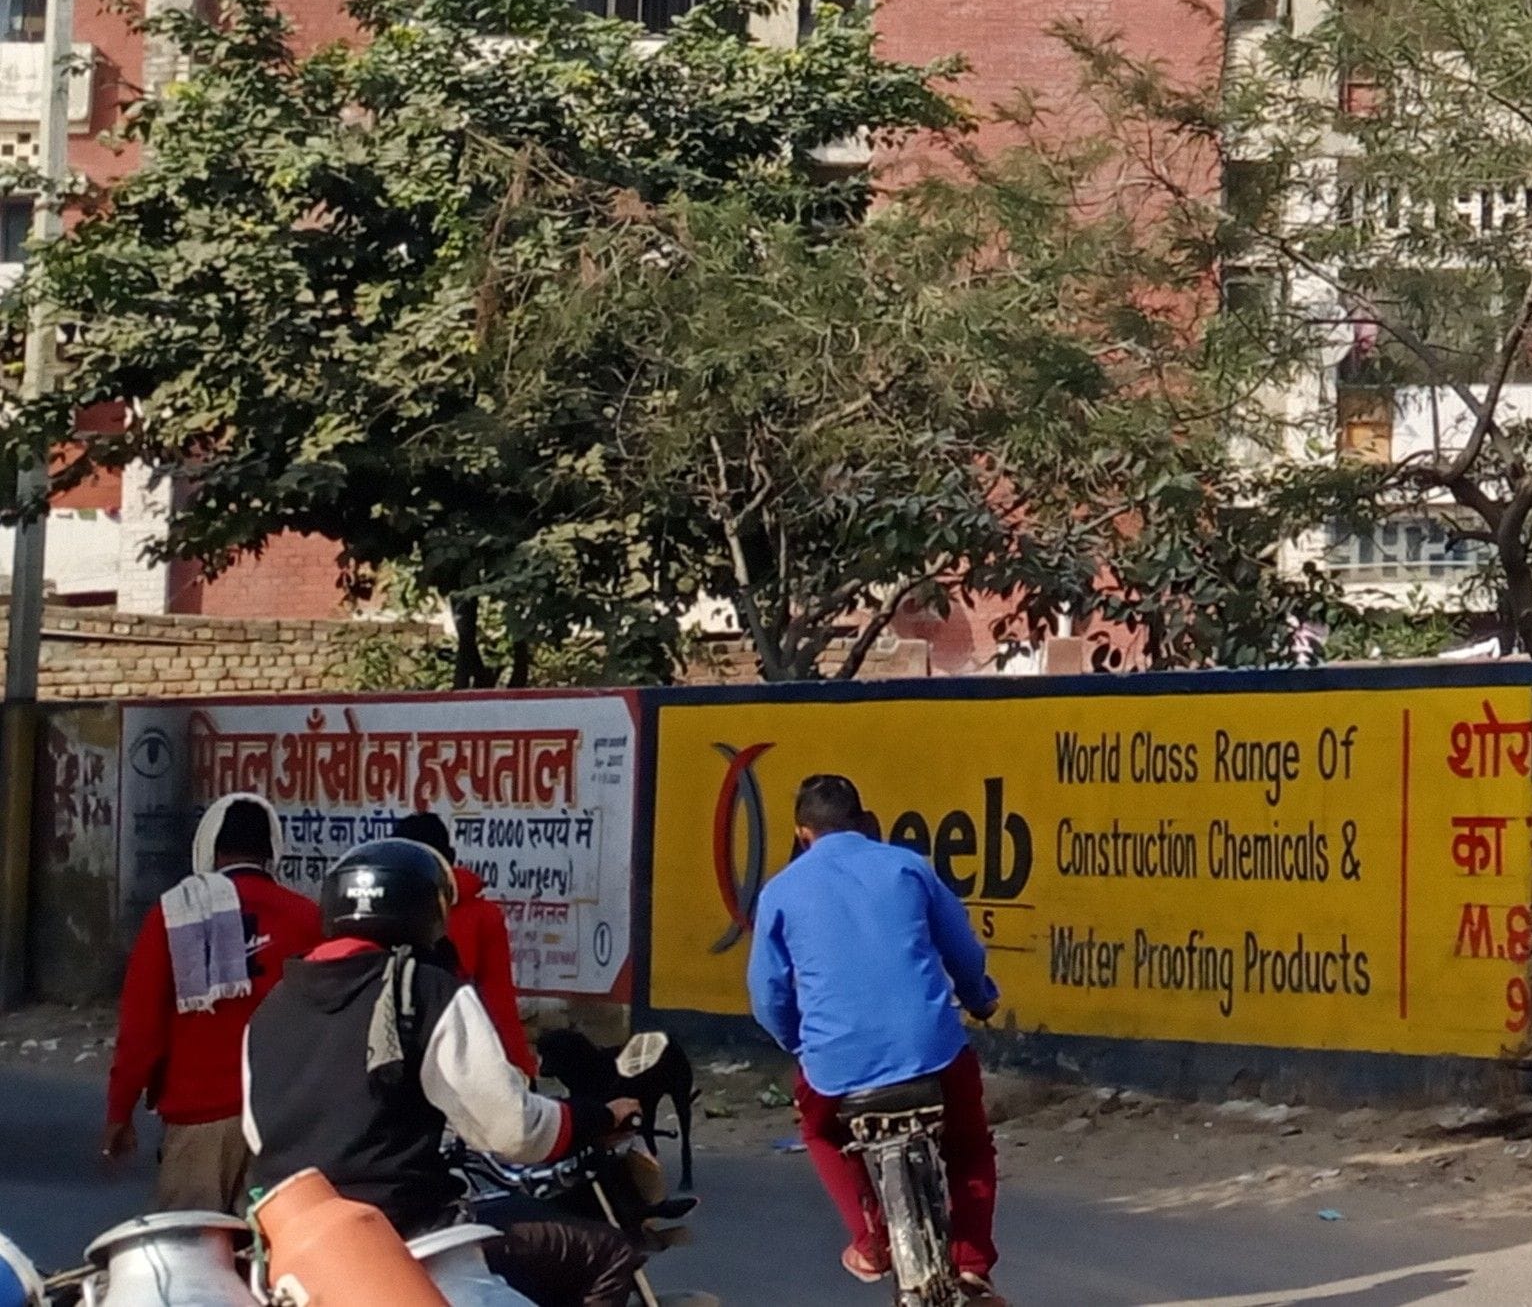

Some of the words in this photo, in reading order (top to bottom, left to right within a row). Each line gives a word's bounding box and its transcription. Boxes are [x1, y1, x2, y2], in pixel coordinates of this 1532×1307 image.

[365, 731, 412, 804] का
[1055, 729, 1121, 784] World
[1130, 730, 1198, 783] Class
[1214, 729, 1300, 806] Range
[1317, 725, 1357, 780] Of
[330, 814, 355, 844] का
[1056, 819, 1198, 879] Construction
[1208, 819, 1329, 882] Chemicals
[1341, 819, 1361, 880] &
[1451, 816, 1507, 877] का
[1048, 925, 1124, 990] Water
[1134, 929, 1232, 1016] Proofing
[1243, 933, 1370, 994] Products
